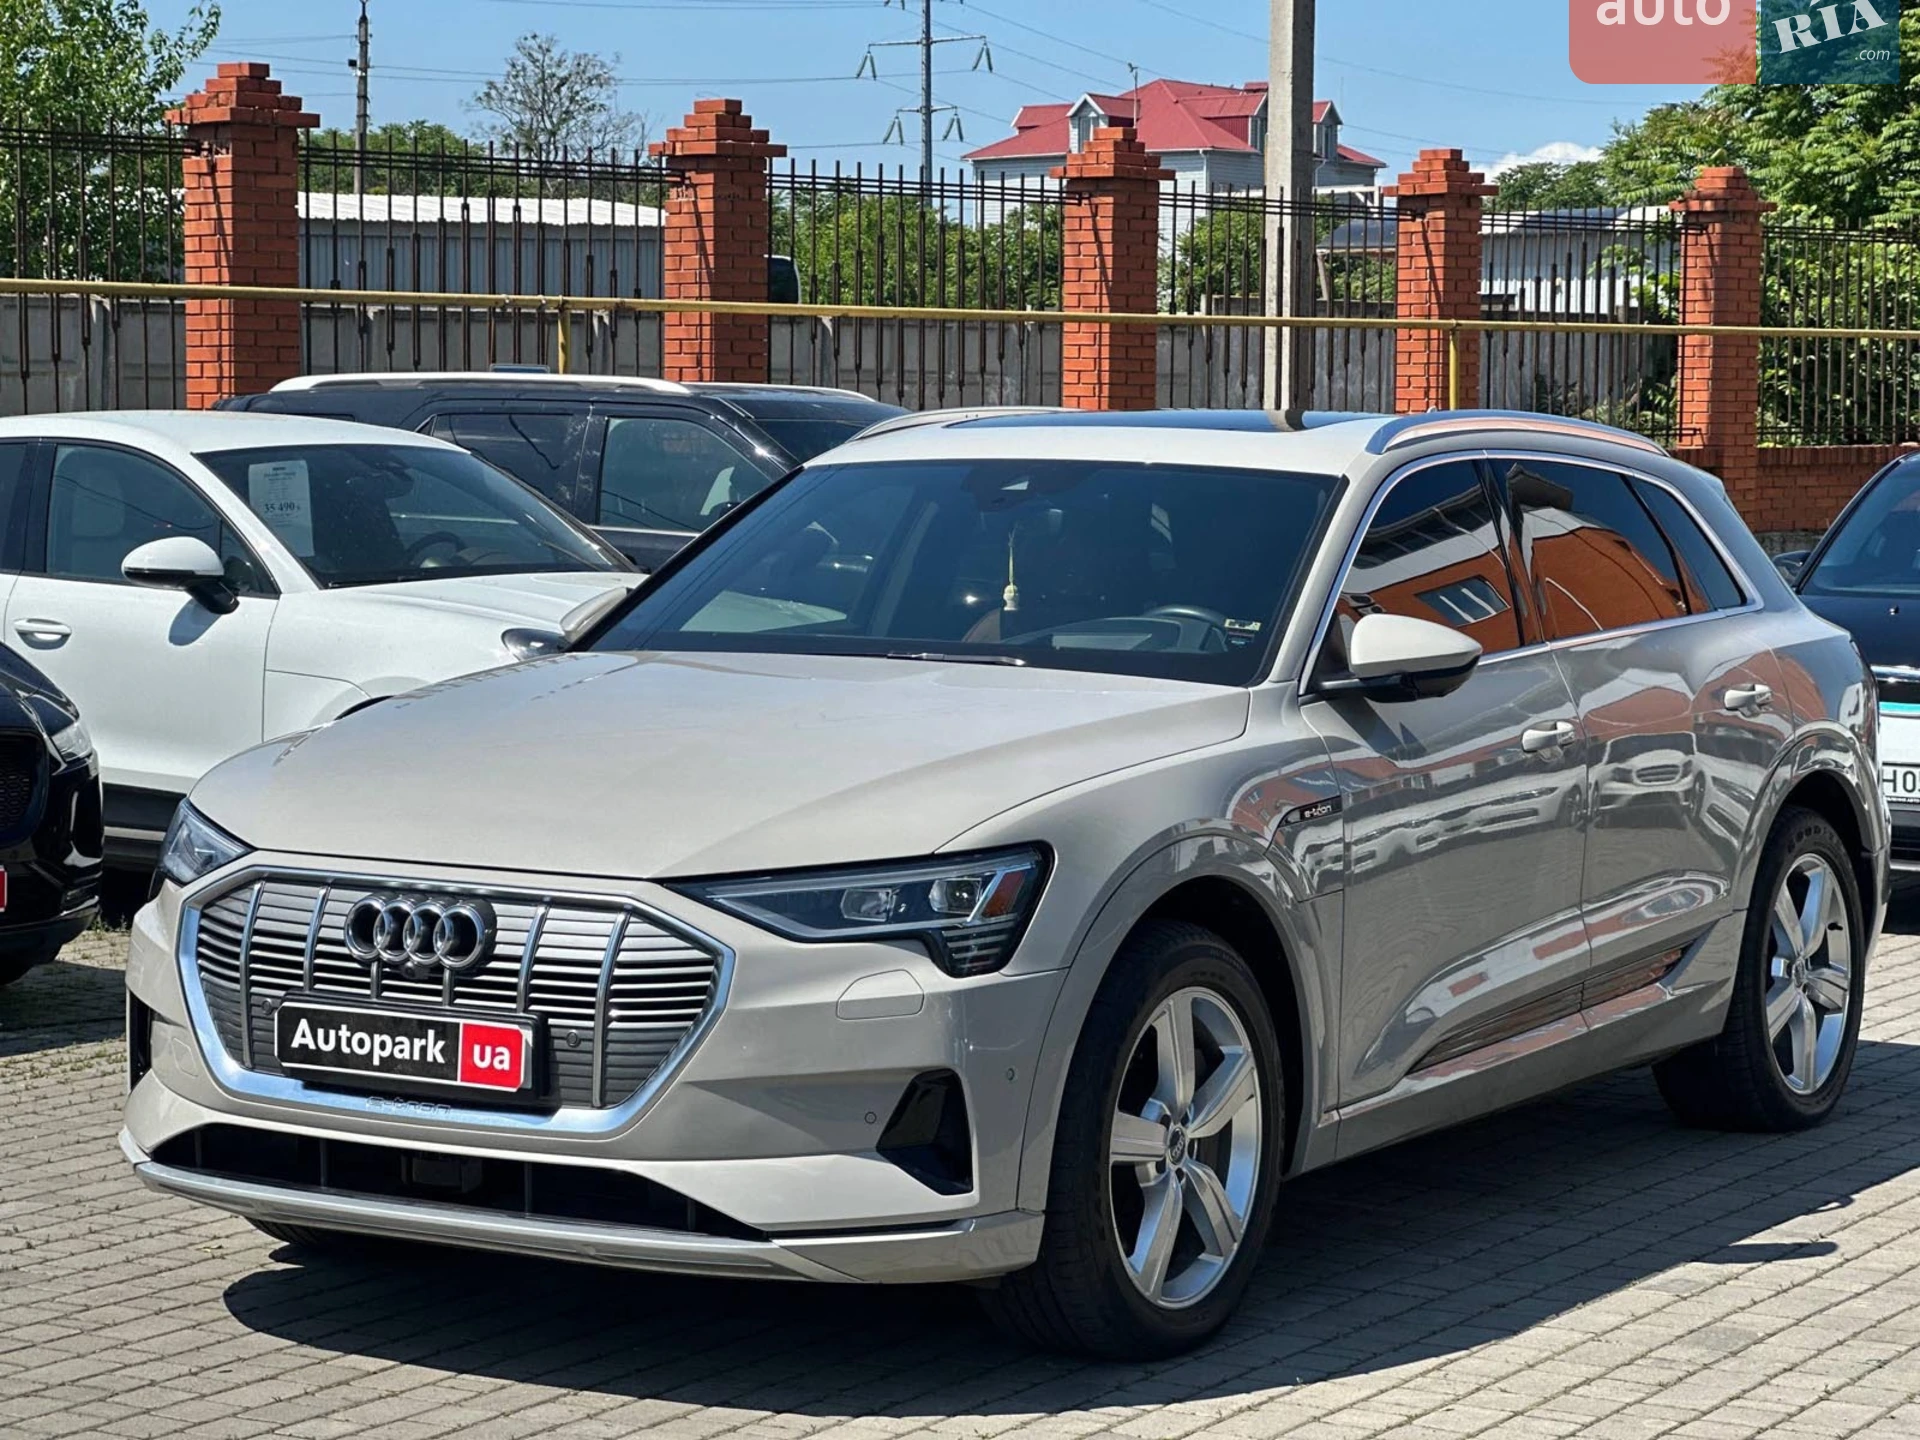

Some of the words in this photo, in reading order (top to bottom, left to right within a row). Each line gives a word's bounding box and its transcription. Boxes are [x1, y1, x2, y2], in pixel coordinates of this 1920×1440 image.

[1304, 804, 1332, 818] e-tron
[291, 1018, 445, 1066] Autopark
[472, 1044, 511, 1071] ua
